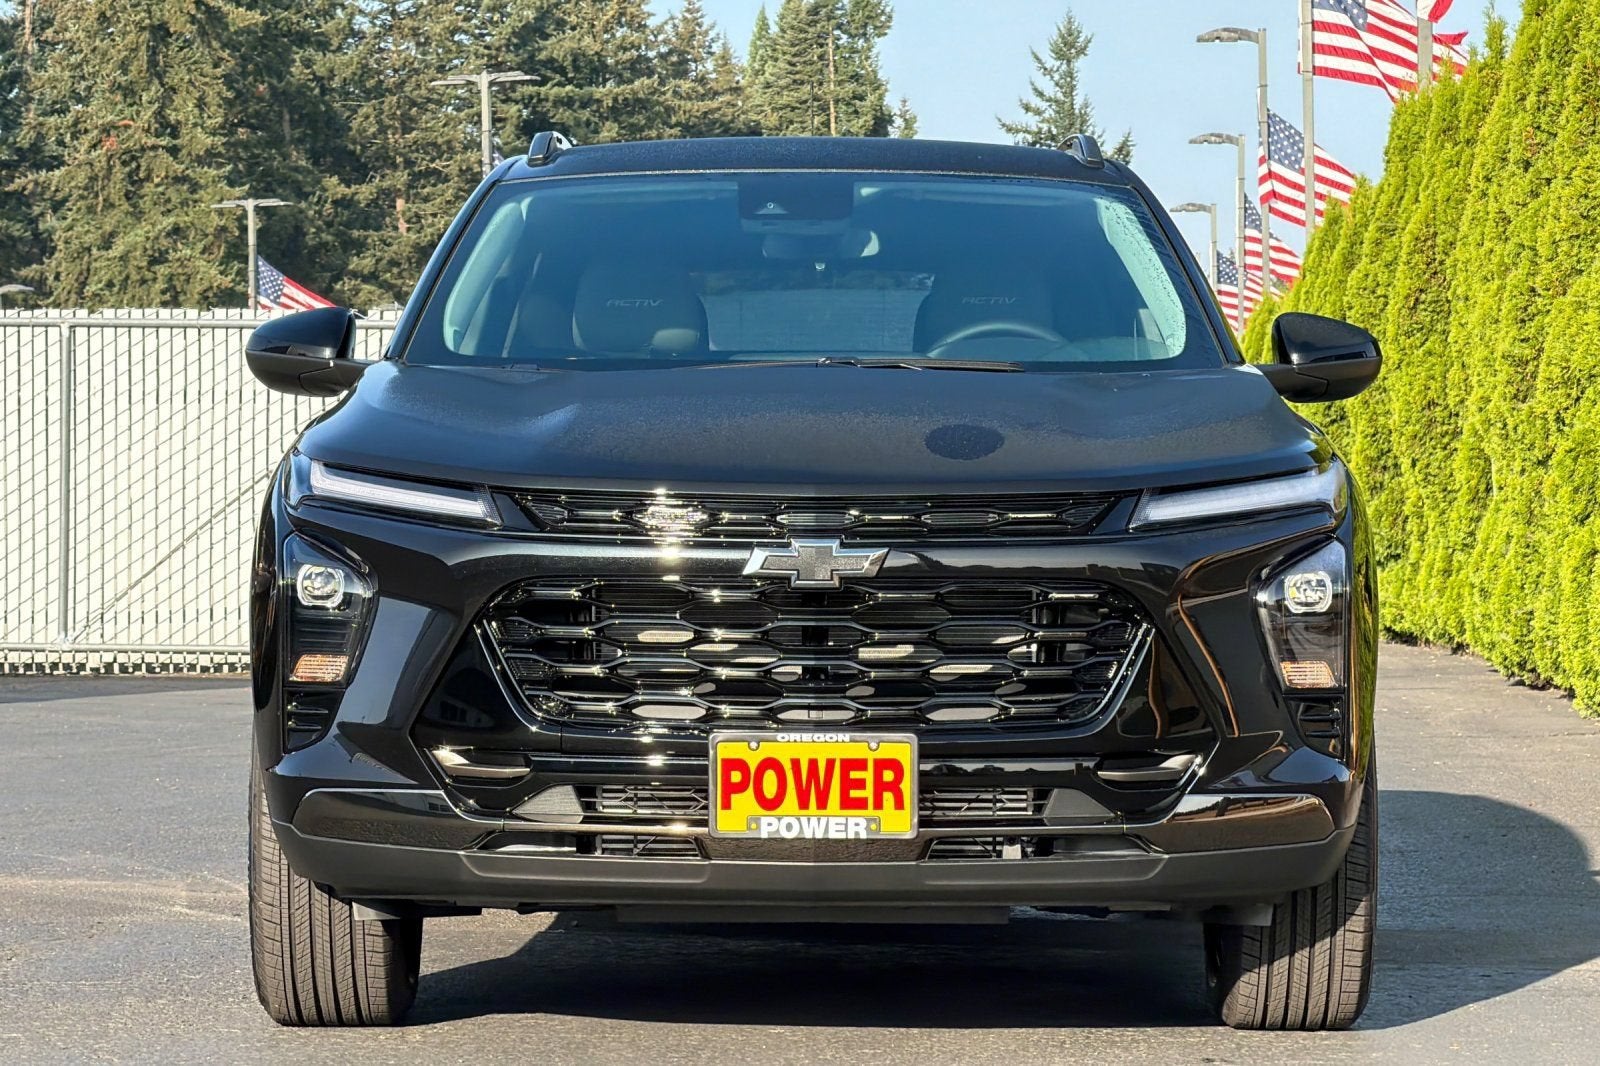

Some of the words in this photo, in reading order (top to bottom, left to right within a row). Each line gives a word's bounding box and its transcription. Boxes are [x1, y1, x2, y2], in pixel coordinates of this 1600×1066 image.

[606, 298, 663, 308] ACTIV
[961, 296, 1016, 305] ACTIV
[776, 733, 850, 742] OREGON
[720, 756, 905, 811] POWER
[760, 816, 868, 839] POWER
